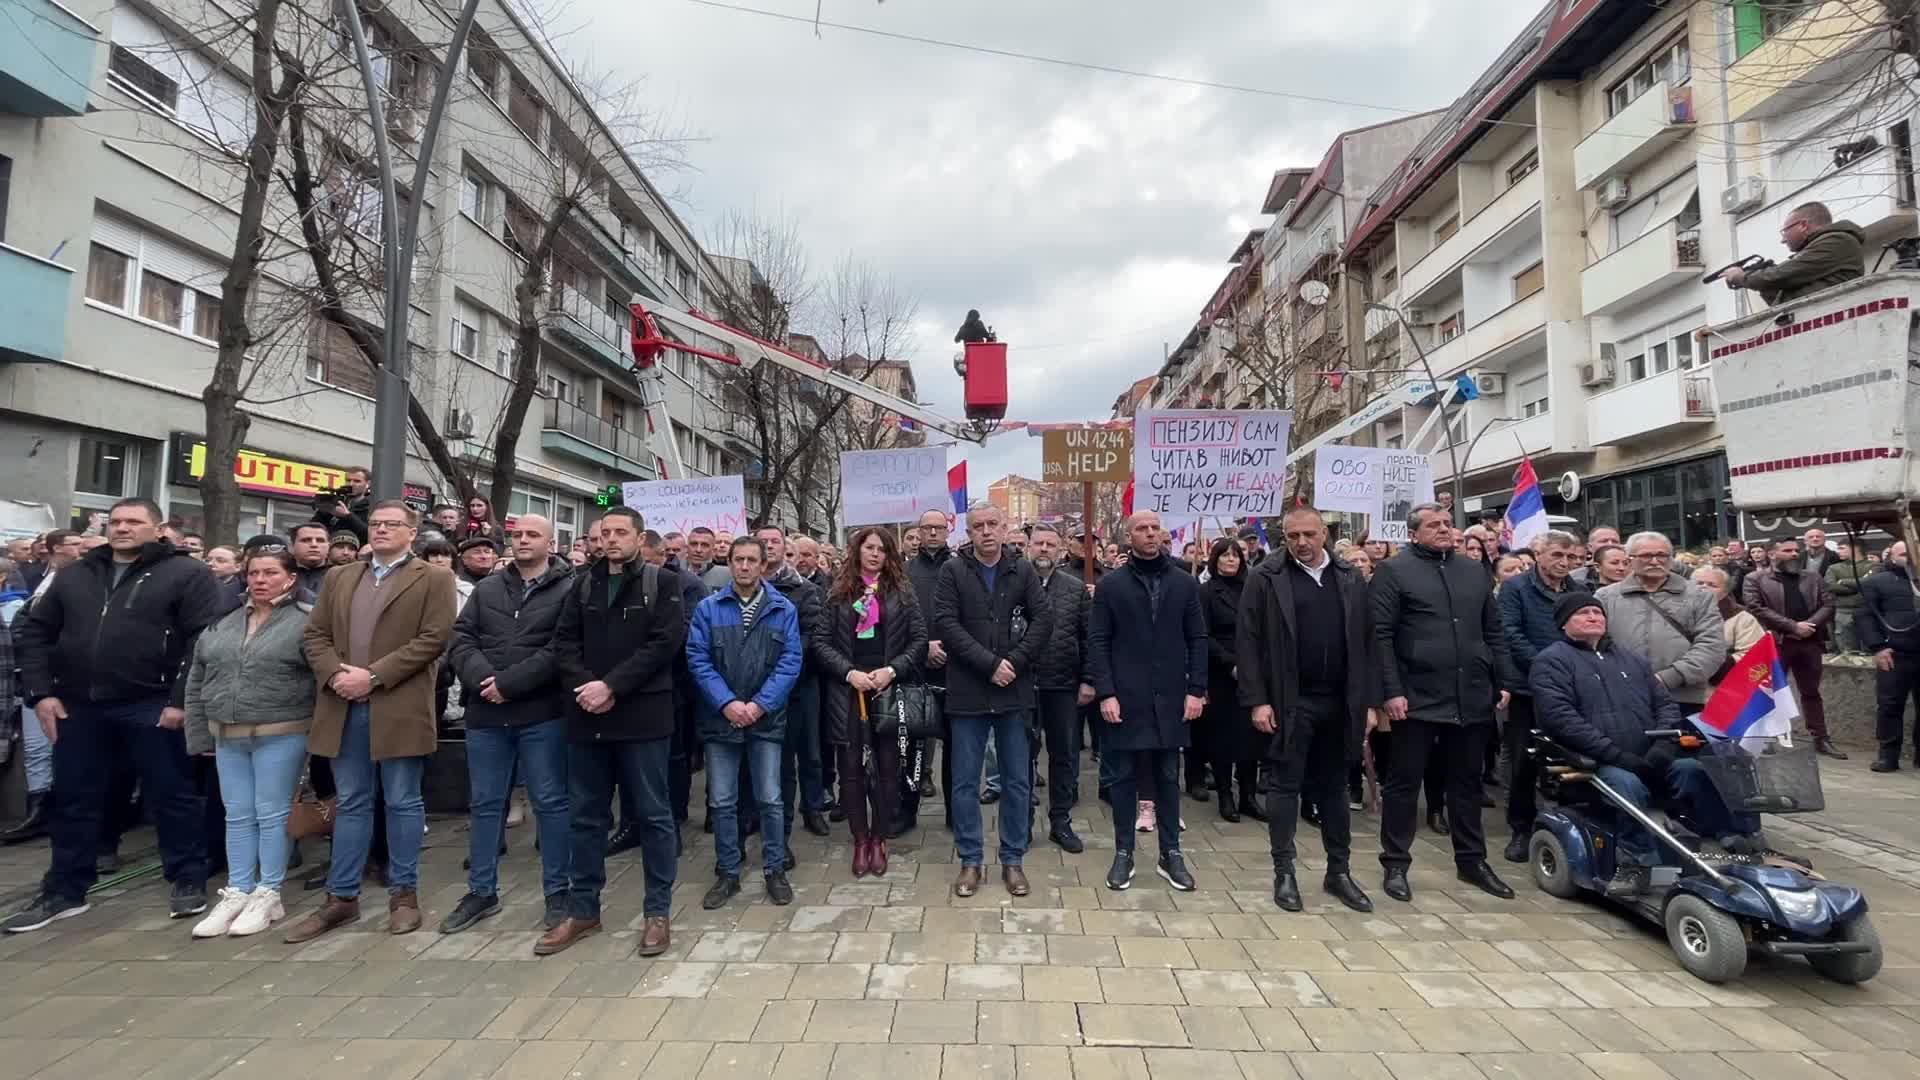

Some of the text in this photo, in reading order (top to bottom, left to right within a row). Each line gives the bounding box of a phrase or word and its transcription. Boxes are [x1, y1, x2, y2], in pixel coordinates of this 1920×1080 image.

[1066, 430, 1124, 448] UN 1244
[1243, 421, 1279, 441] САМ
[1043, 462, 1064, 476] USA
[1068, 451, 1117, 477] HELP
[1151, 448, 1276, 471] ЧИТАВ ЖИВОТ
[1331, 459, 1367, 476] ОВО
[234, 456, 341, 489] UTLET
[1226, 472, 1245, 490] НЕ
[1247, 472, 1284, 492] ДАМ
[1383, 466, 1416, 483] НИЈЕ
[1150, 494, 1171, 513] ЈЕ
[1382, 523, 1406, 539] КРИ
